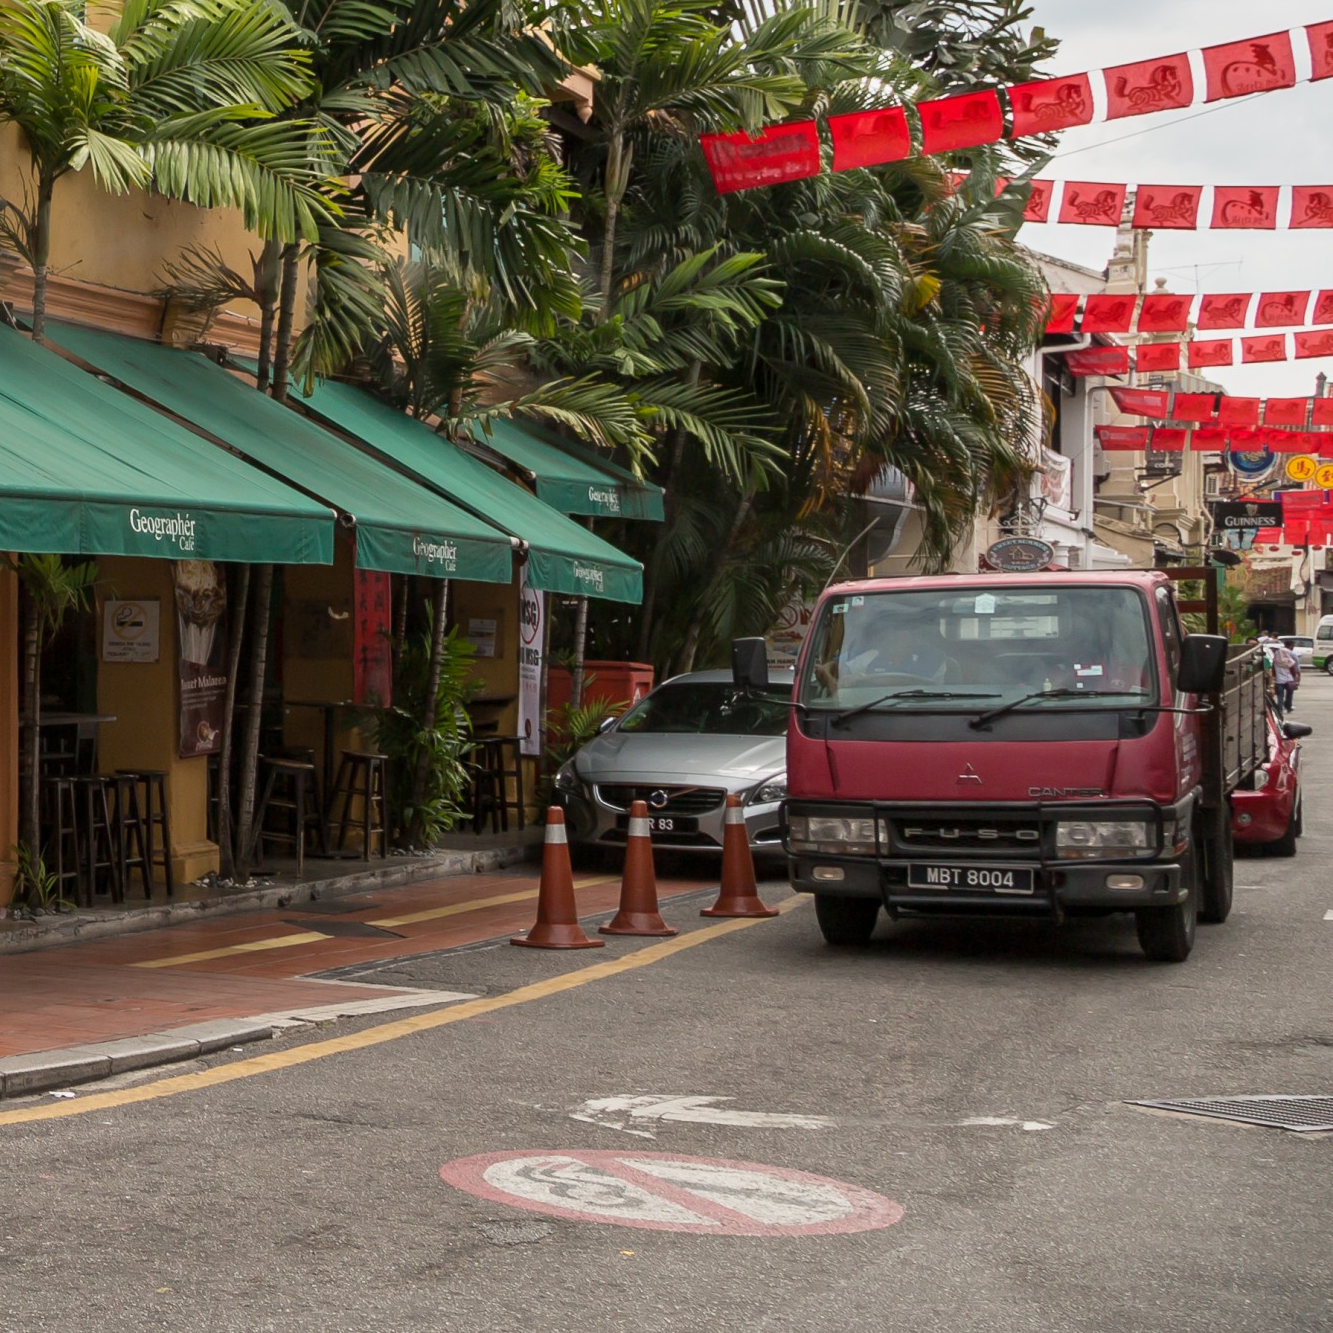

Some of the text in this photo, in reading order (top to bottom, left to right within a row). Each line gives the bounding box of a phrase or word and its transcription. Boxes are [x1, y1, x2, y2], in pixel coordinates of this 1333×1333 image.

[130, 509, 196, 542] Geographér
[1224, 515, 1276, 527] GUINNESS
[179, 535, 195, 551] Café
[659, 818, 674, 830] 83
[904, 828, 1040, 840] FUSO
[927, 867, 1014, 887] MBT 8004
